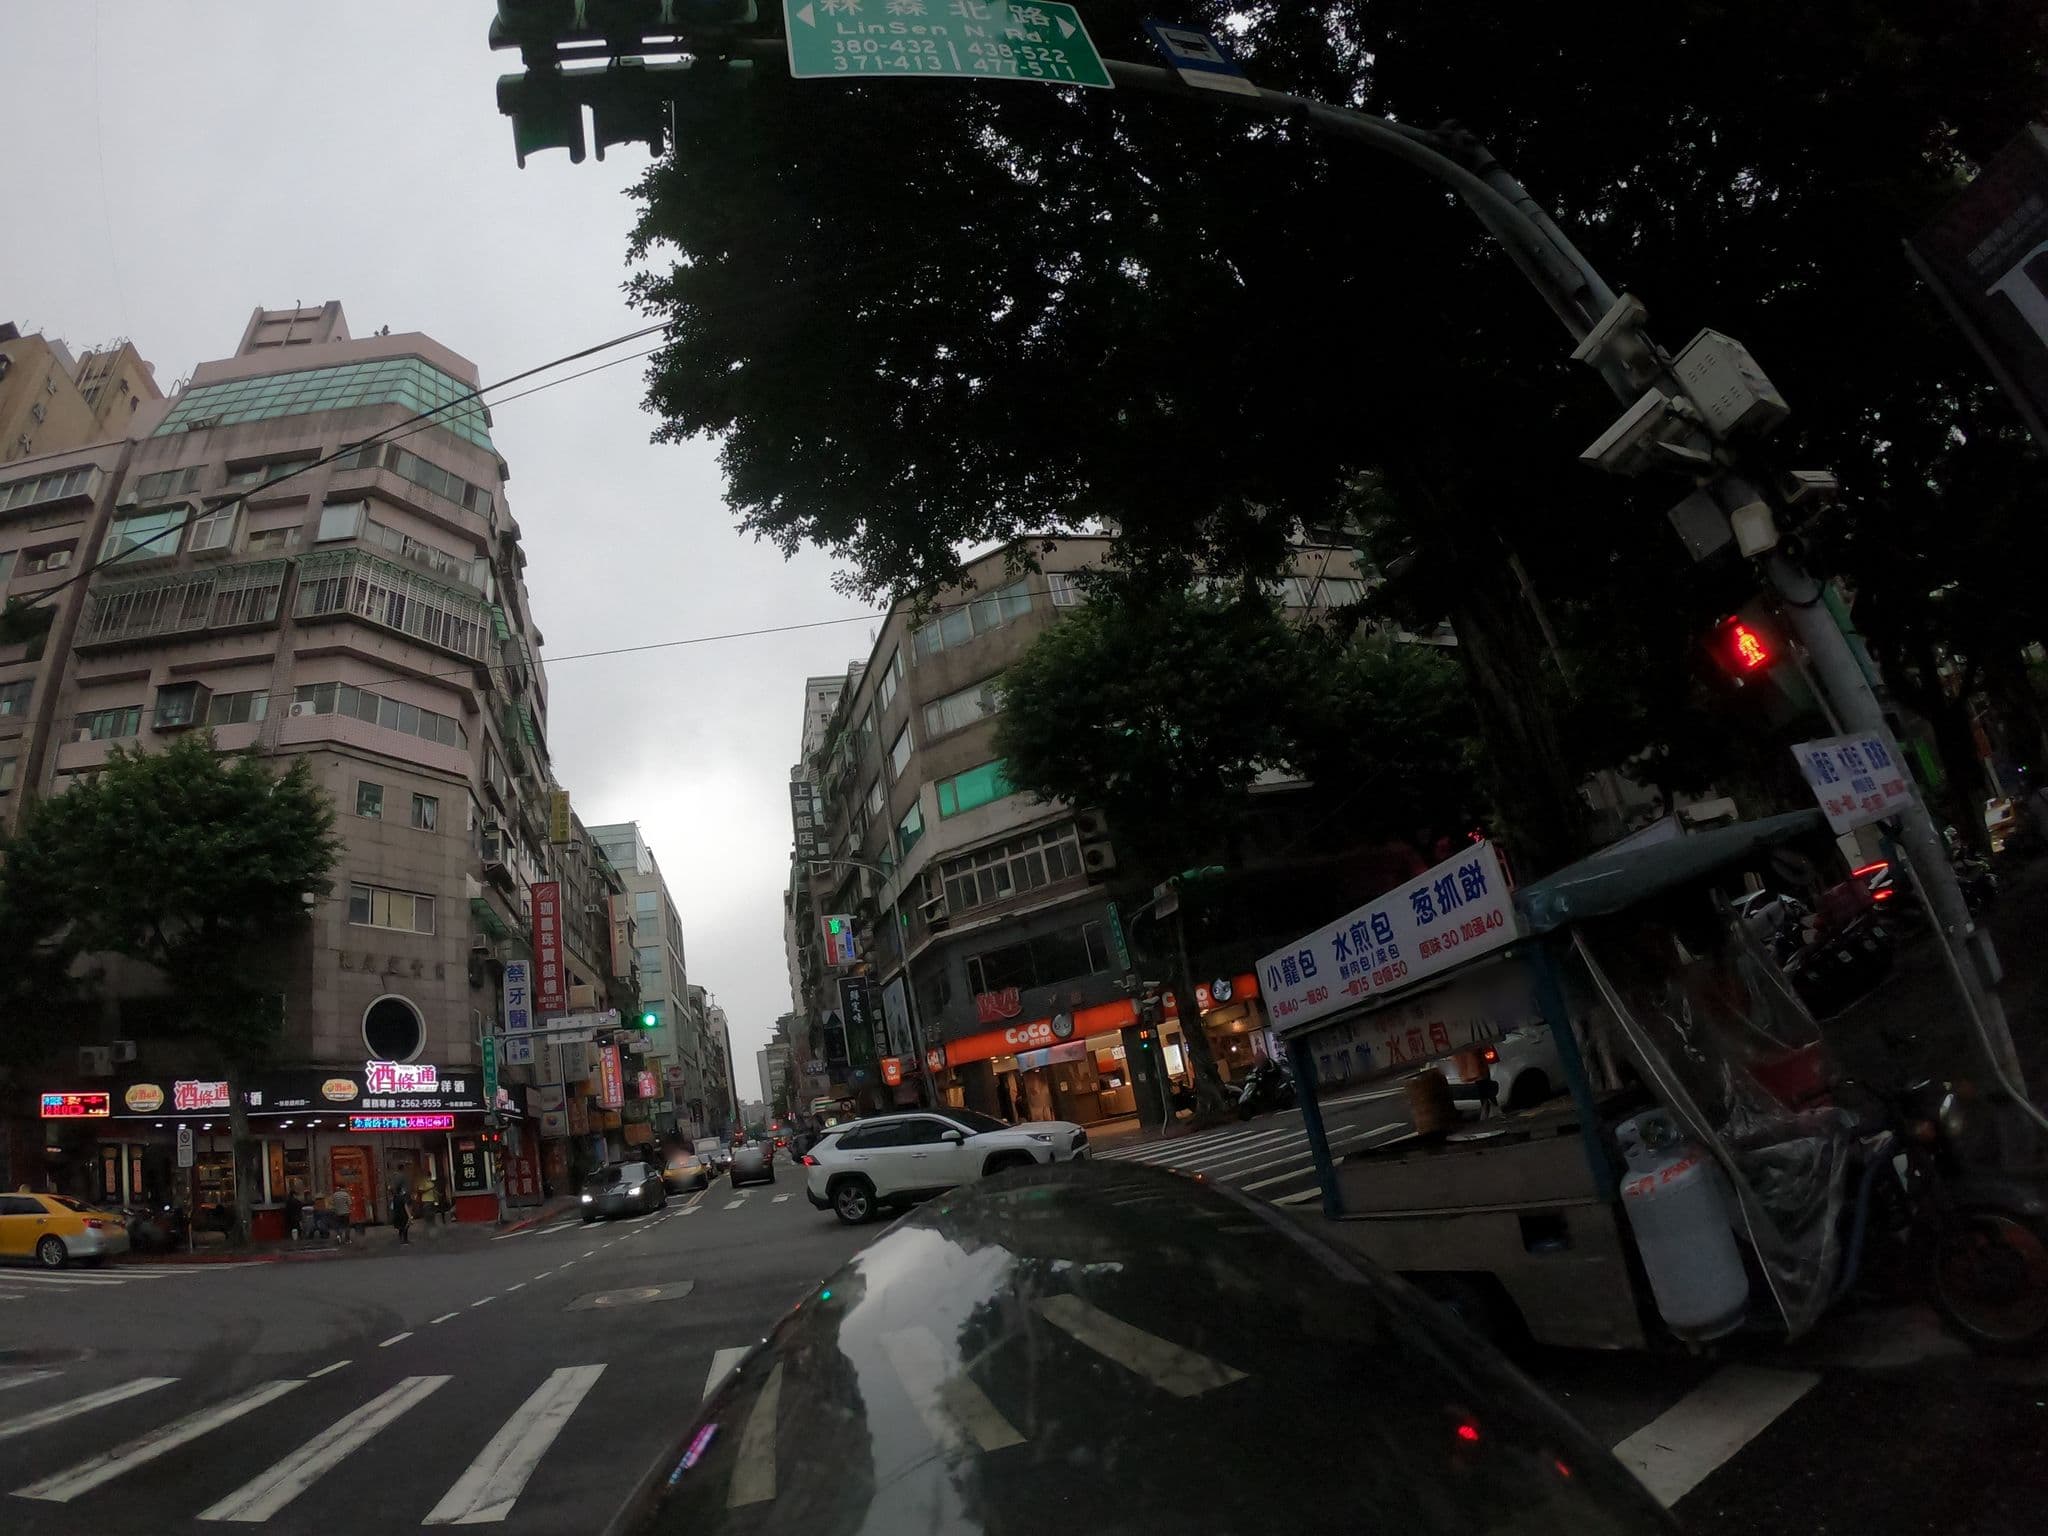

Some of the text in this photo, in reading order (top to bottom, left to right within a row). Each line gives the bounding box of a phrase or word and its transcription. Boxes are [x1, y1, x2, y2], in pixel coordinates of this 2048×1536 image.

[836, 21, 1050, 43] LinSen N. Rd.
[831, 39, 1069, 64] 380-432 438-522
[833, 55, 1076, 80] 371-413 477-511
[1460, 909, 1503, 942] 加蛋40
[1267, 949, 1317, 992] 小籠包
[1332, 912, 1394, 962] 水煎包
[1005, 1024, 1050, 1044] CoCo
[366, 1061, 439, 1094] 酒條通
